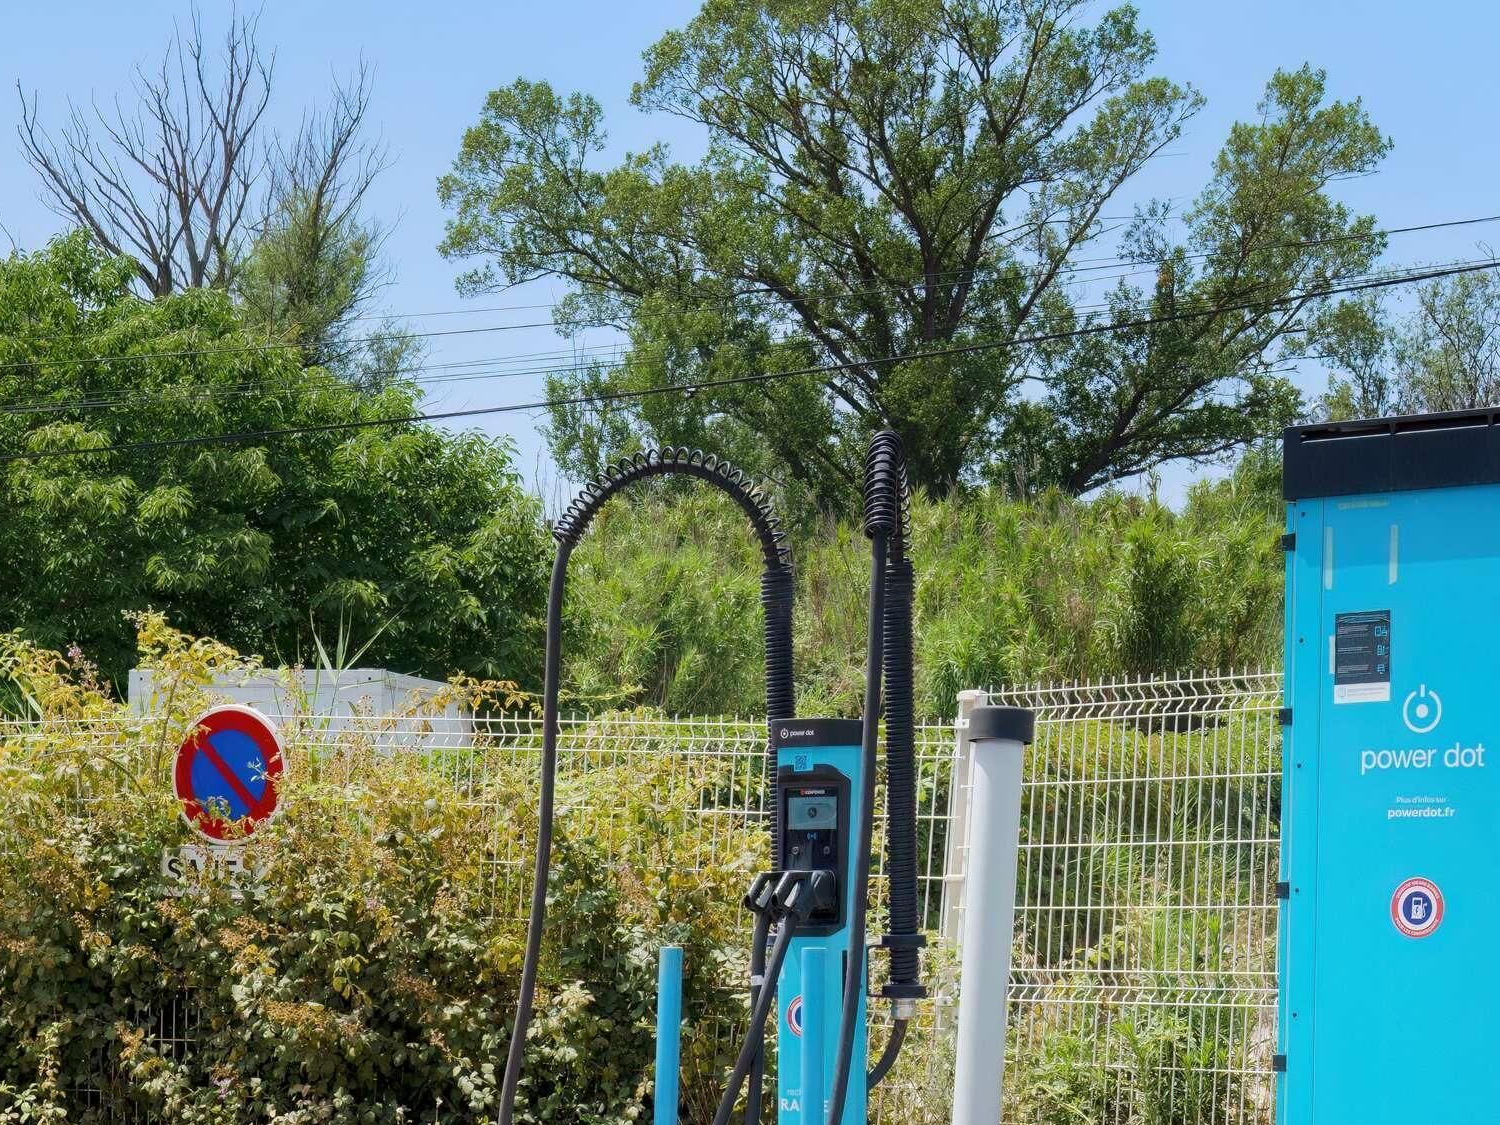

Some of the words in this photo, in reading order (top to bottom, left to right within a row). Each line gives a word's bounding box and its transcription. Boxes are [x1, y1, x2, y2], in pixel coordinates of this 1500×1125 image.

[1361, 748, 1437, 775] power
[1444, 742, 1486, 767] dot
[1387, 806, 1455, 820] powerdot.fr
